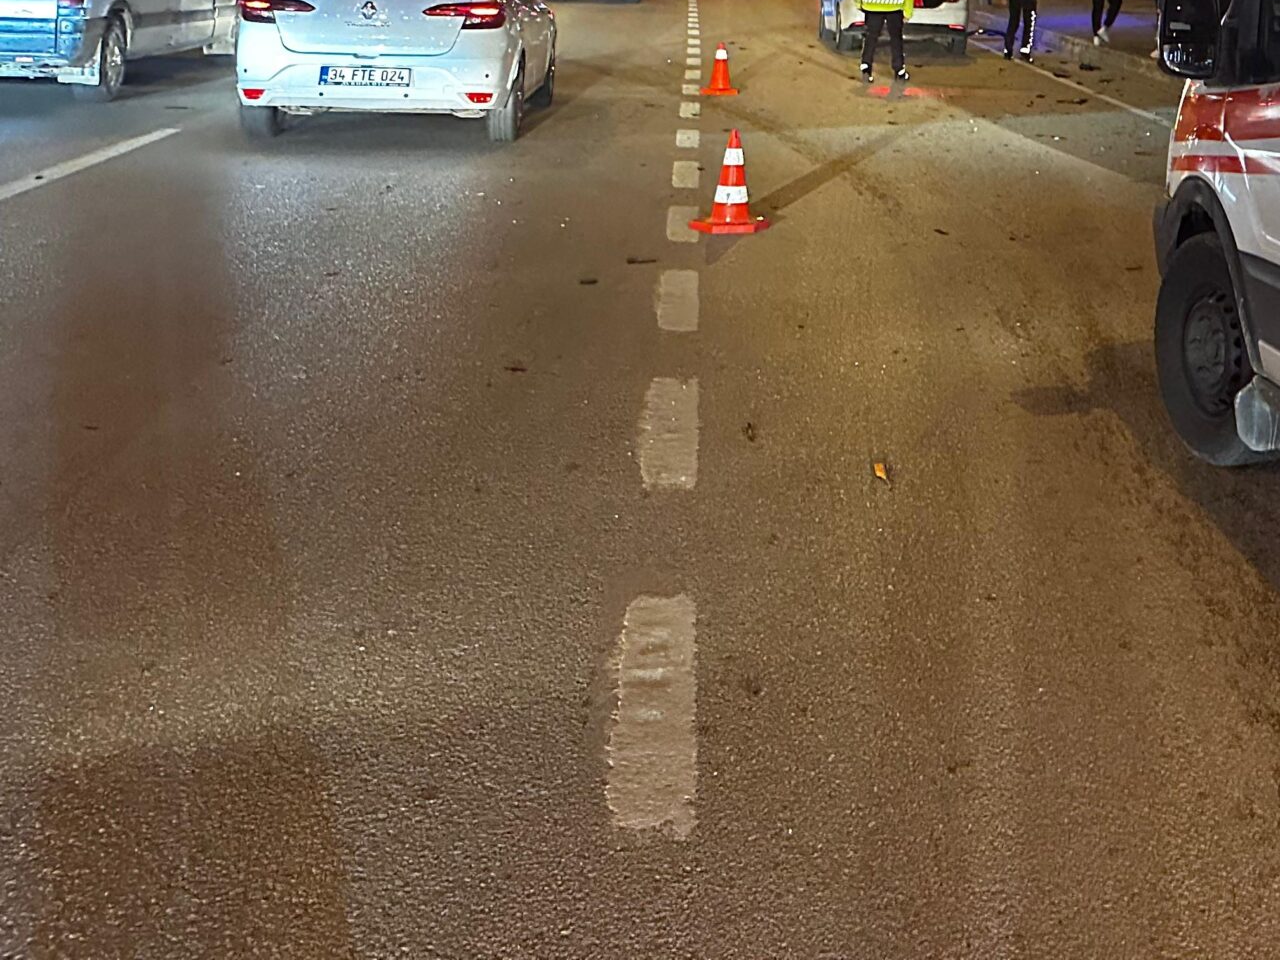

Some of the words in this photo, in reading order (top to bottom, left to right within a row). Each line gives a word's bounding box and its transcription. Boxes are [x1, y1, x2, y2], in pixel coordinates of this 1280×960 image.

[329, 68, 346, 81] 34
[351, 69, 377, 82] FTE
[381, 70, 405, 82] 024
